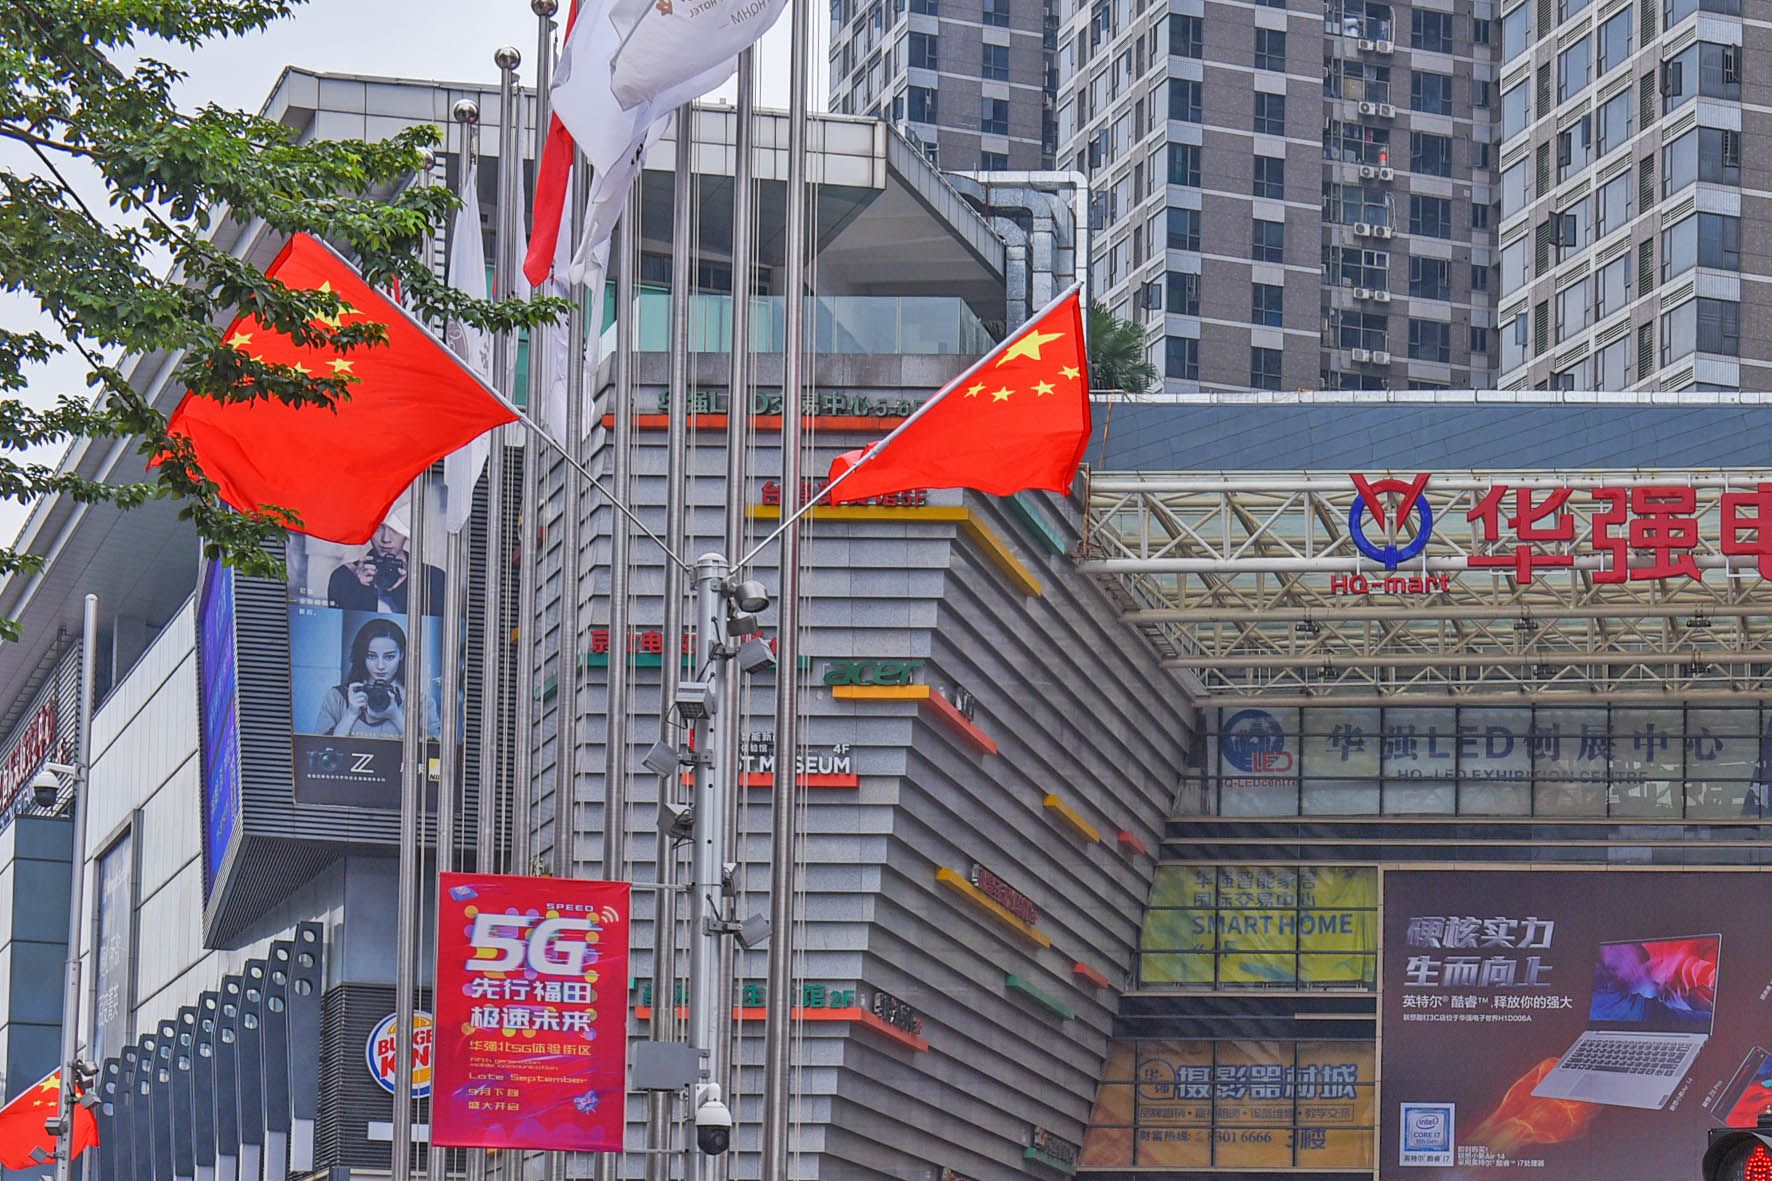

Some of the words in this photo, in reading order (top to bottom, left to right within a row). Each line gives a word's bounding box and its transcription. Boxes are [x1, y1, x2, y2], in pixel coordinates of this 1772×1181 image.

[1331, 574, 1450, 595] HQ-mart
[823, 660, 925, 685] acer
[833, 743, 850, 754] 4F
[759, 755, 851, 774] MSEUM
[1252, 751, 1293, 773] LED
[1193, 916, 1272, 935] SMART
[1279, 914, 1353, 935] HOME
[1407, 916, 1556, 949] 硬核实力
[465, 913, 597, 977] 5G
[1403, 955, 1553, 988] 生而向上
[471, 978, 593, 1003] 先行福田
[470, 1006, 593, 1032] 极速未来
[469, 1039, 592, 1056] 华强北5G体验街区
[469, 1072, 504, 1081] Late
[510, 1073, 588, 1084] September
[1177, 1064, 1358, 1100] 摄影器材城
[468, 1101, 520, 1111] 盛大开启
[1418, 1117, 1437, 1127] intel
[1241, 1132, 1272, 1143] 6666
